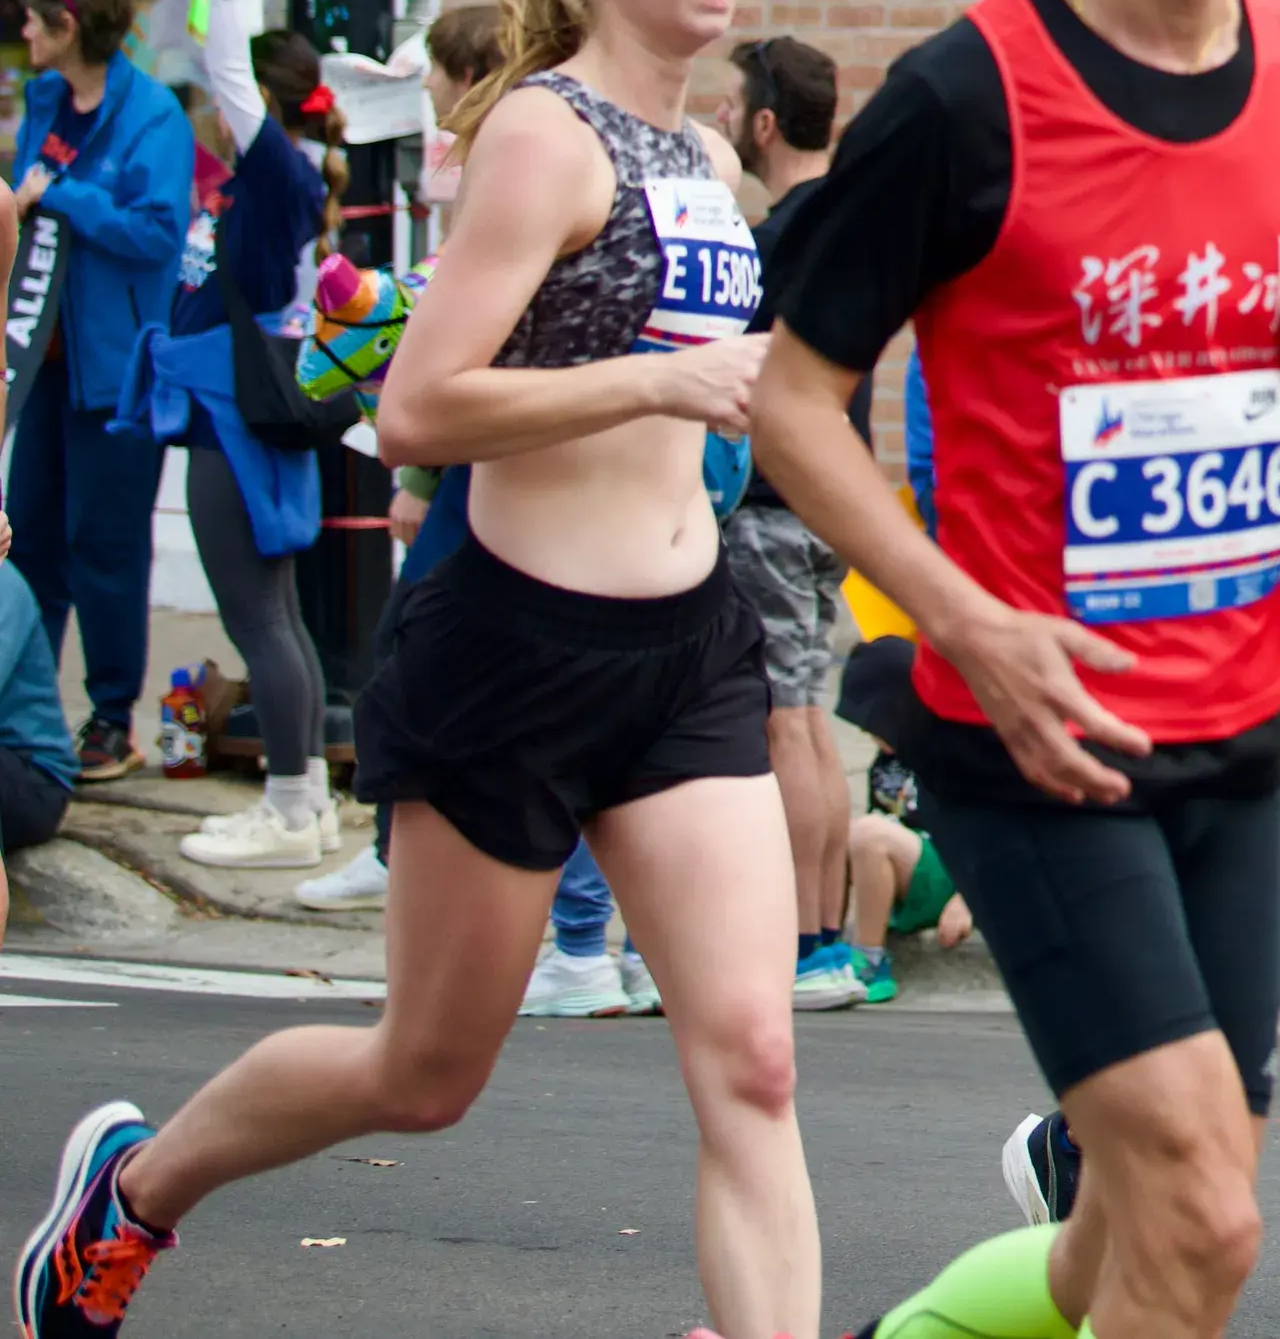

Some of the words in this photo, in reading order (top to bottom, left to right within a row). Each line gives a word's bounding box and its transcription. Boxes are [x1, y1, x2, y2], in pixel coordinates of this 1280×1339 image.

[6, 216, 58, 348] ALLEN
[663, 244, 688, 301] E
[1071, 461, 1120, 539] C
